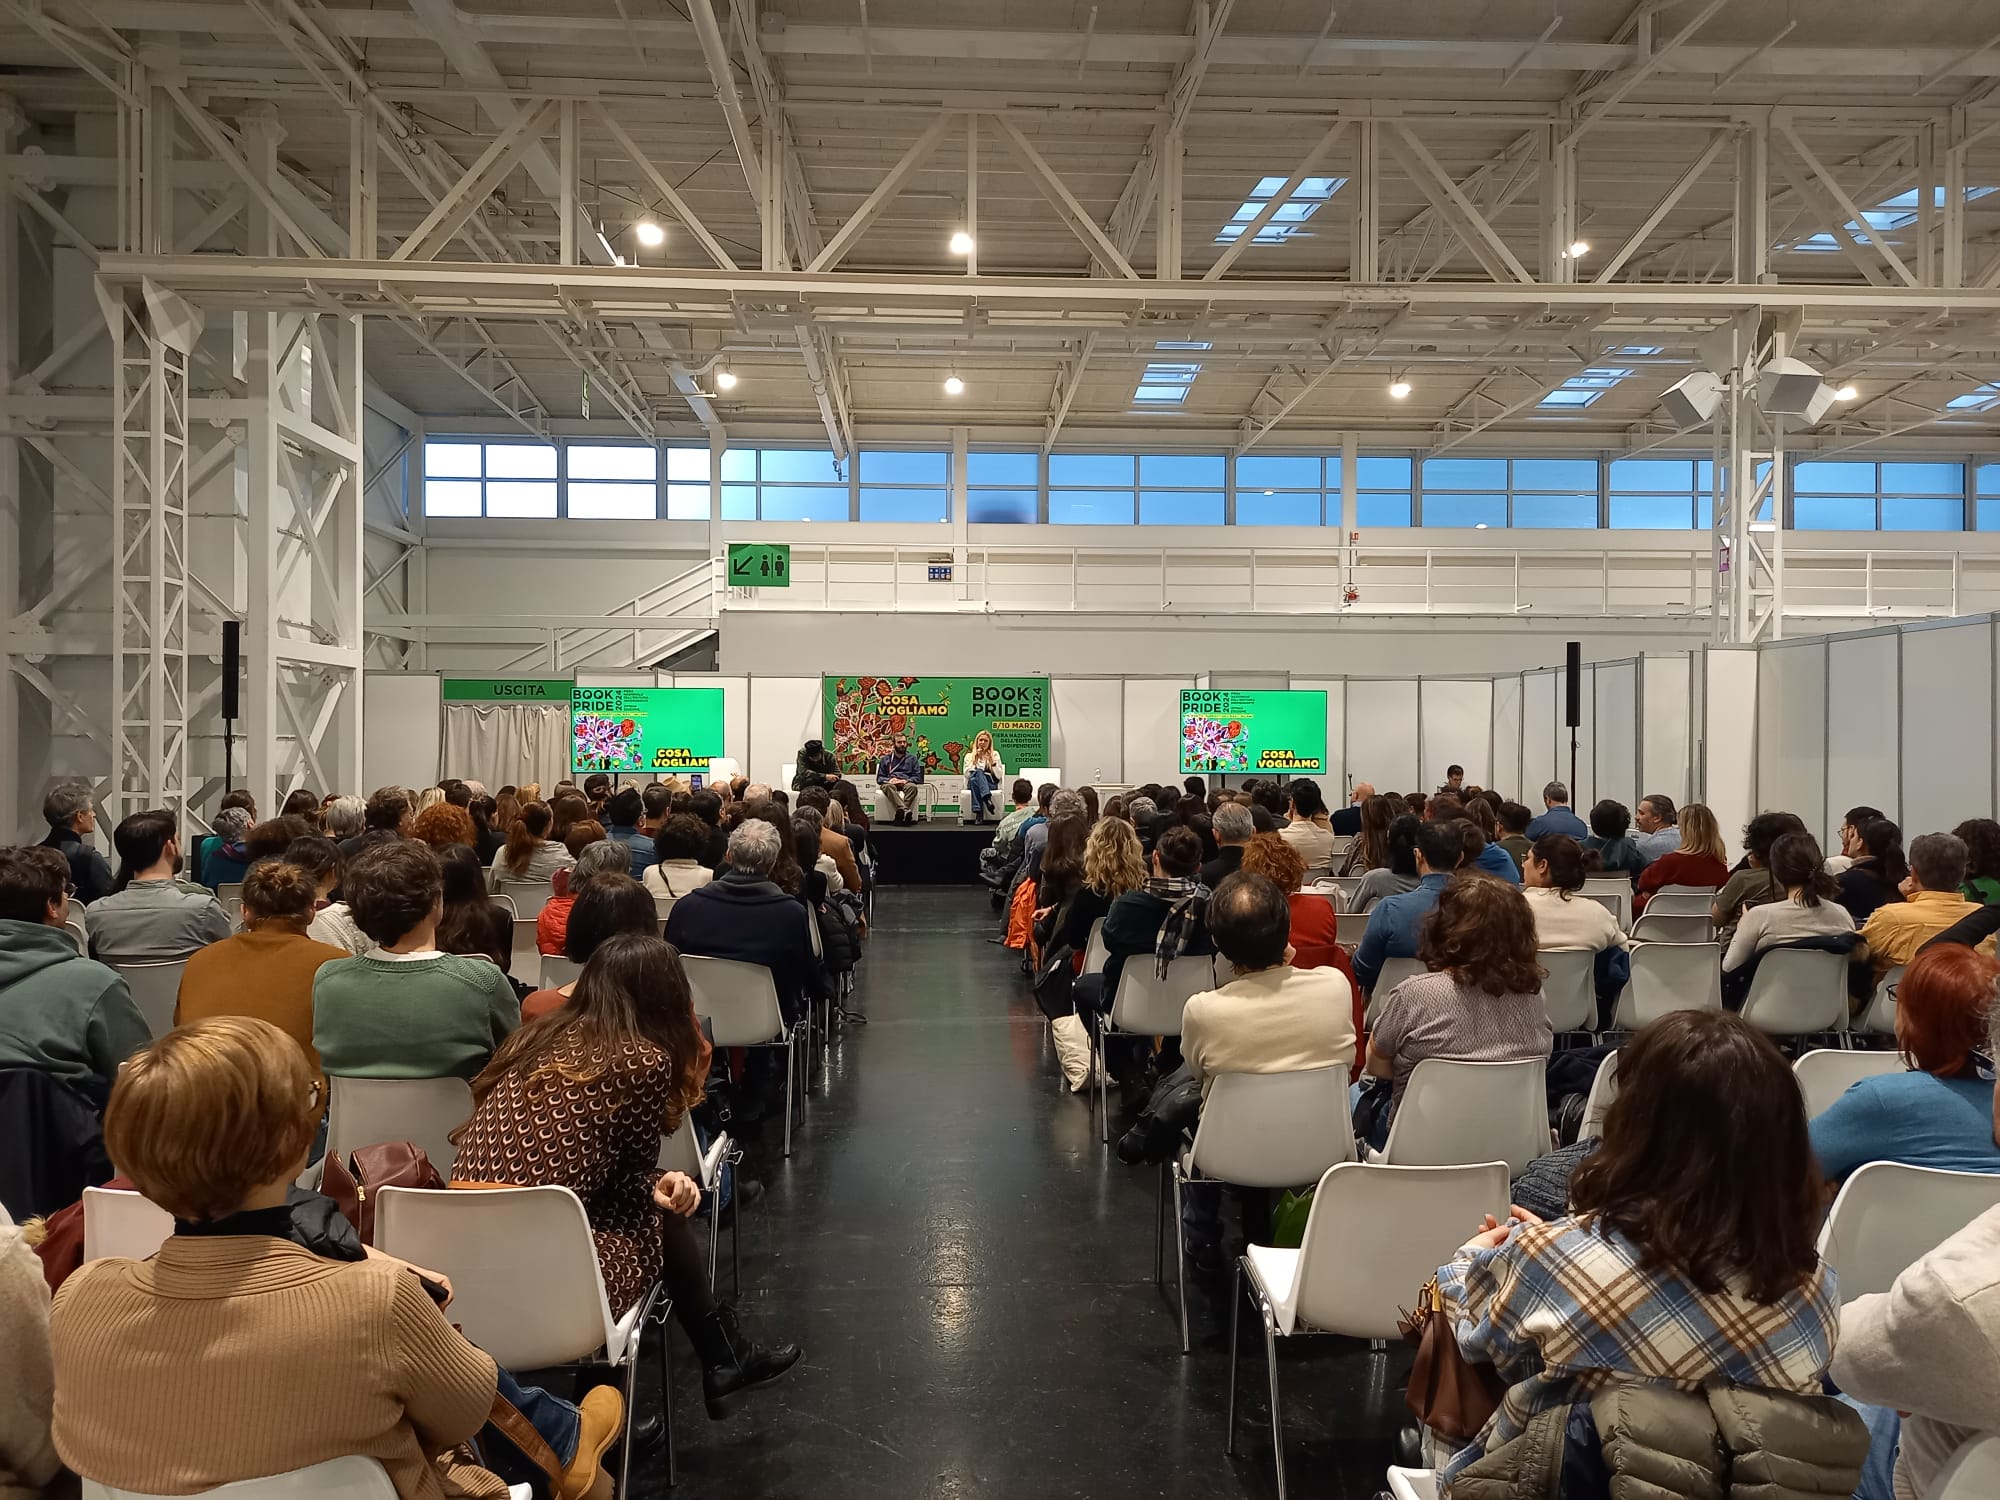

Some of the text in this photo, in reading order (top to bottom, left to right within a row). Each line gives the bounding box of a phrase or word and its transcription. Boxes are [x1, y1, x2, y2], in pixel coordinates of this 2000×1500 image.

[494, 684, 546, 695] USCITA
[972, 687, 1030, 701] BOOK
[573, 690, 613, 699] BOOK
[1183, 692, 1221, 701] BOOK
[882, 696, 918, 705] COSA
[1033, 687, 1042, 717] 2024
[573, 701, 613, 711] PRIDE
[877, 706, 948, 715] VOGLIAMO
[972, 703, 1030, 717] PRIDE
[1183, 703, 1221, 712] PRIDE
[657, 749, 690, 757] COSA
[1262, 750, 1294, 759] COSA
[653, 758, 709, 767] VOGLIAM
[1257, 759, 1319, 768] VOGLIAMO
